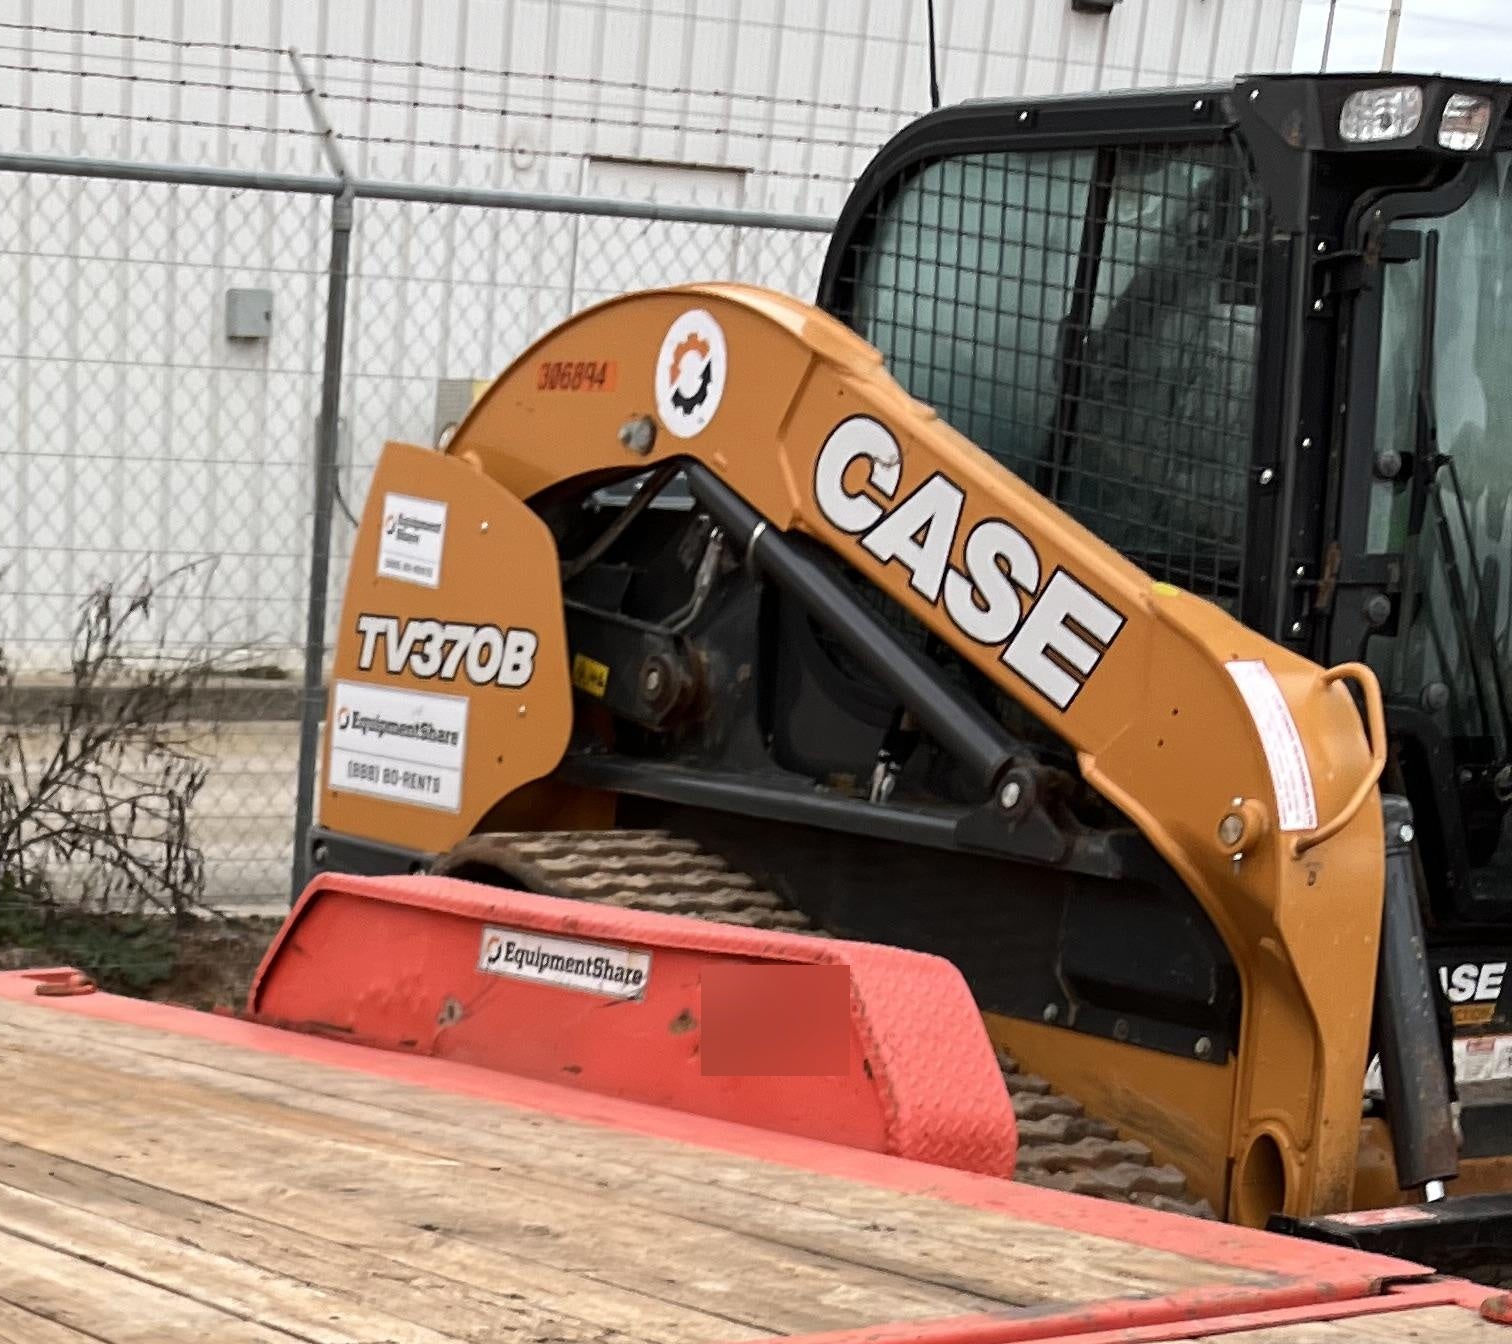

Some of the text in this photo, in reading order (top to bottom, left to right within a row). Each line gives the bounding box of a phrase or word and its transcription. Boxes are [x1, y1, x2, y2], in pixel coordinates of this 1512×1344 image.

[814, 413, 1128, 713] CASE
[357, 613, 538, 690] TV370B
[351, 710, 460, 747] EquipmentShare
[503, 941, 644, 986] EquipmentShare
[1438, 962, 1507, 1003] SE
